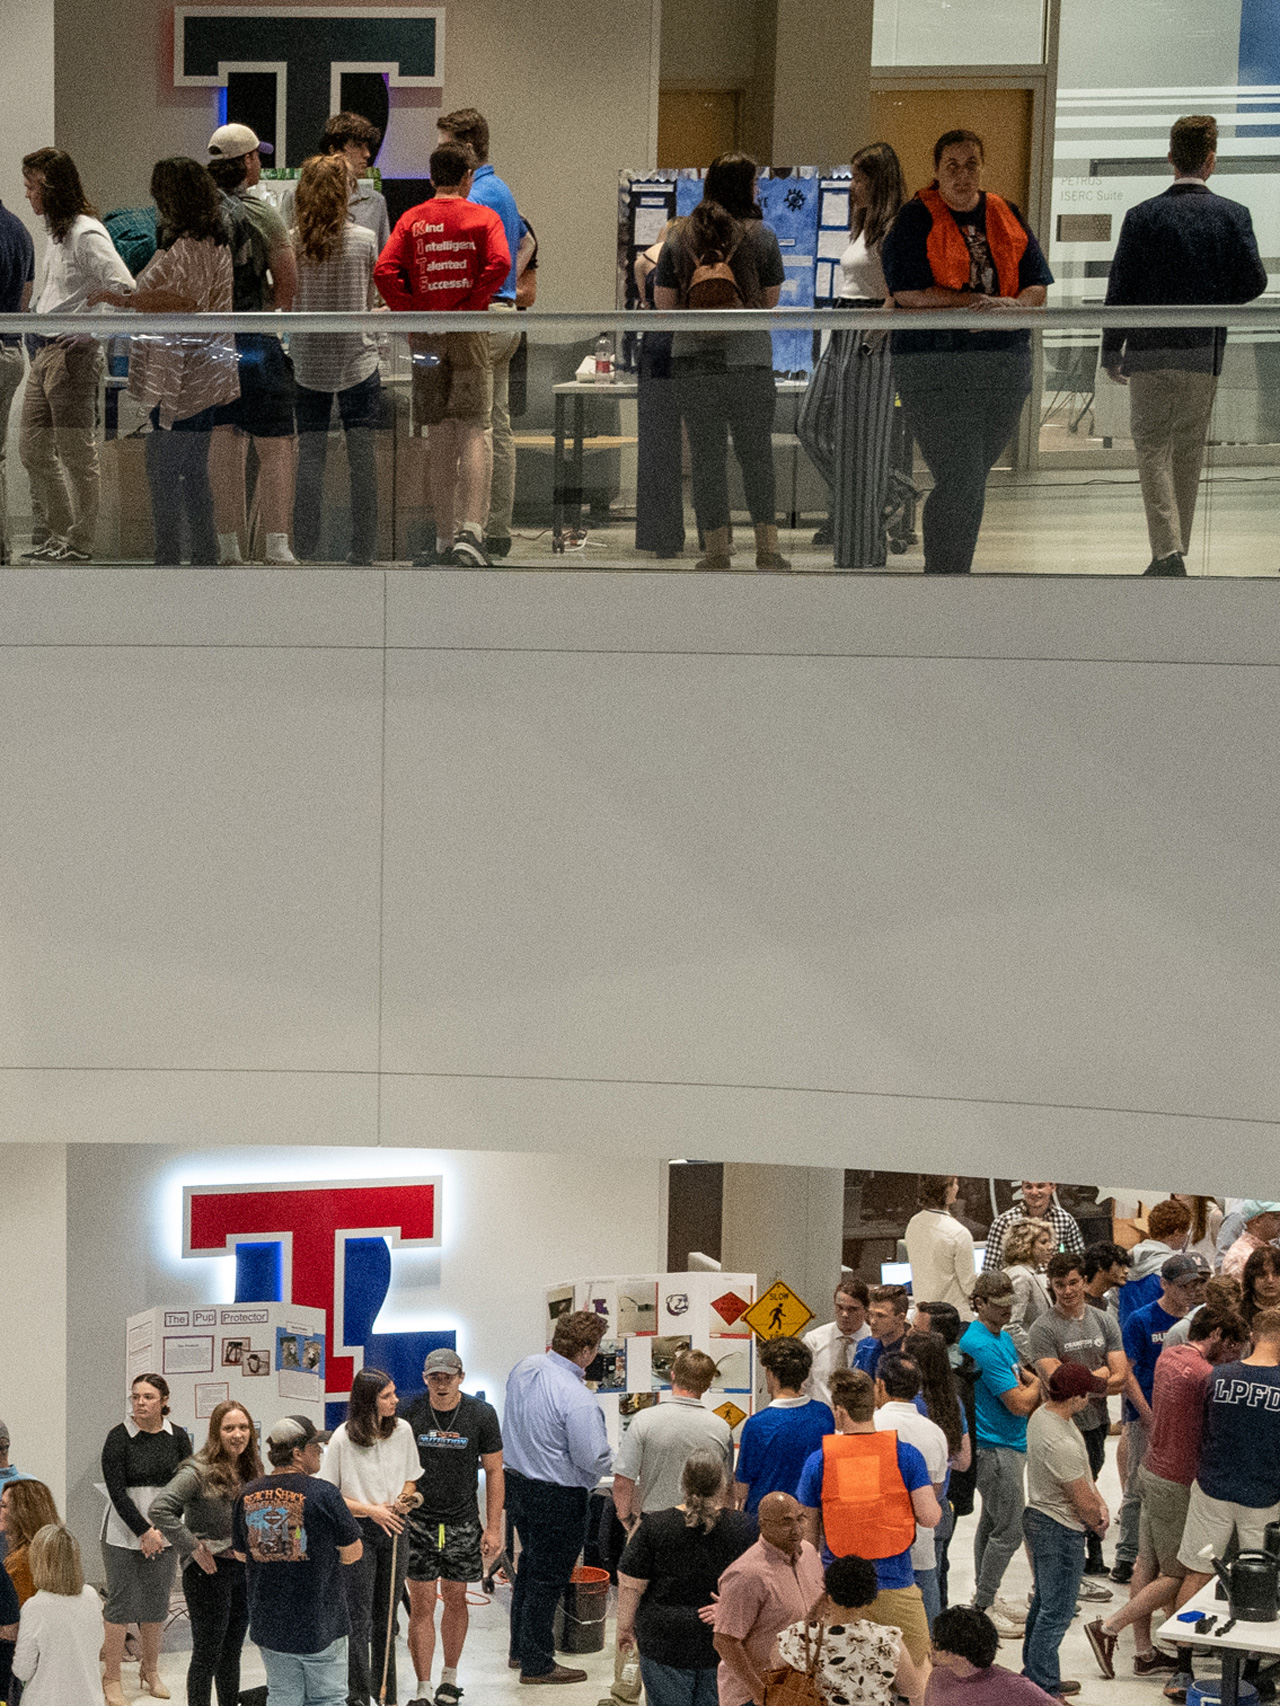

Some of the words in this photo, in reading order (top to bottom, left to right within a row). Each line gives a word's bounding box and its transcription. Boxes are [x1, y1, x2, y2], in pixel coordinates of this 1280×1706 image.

[1060, 190, 1093, 201] ISERC
[1096, 190, 1124, 201] Suite
[412, 220, 444, 238] Kind
[416, 257, 468, 275] Talented
[167, 1315, 186, 1325] The
[195, 1312, 215, 1323] Pup
[223, 1312, 266, 1323] Protector
[1213, 1378, 1280, 1413] LPFD
